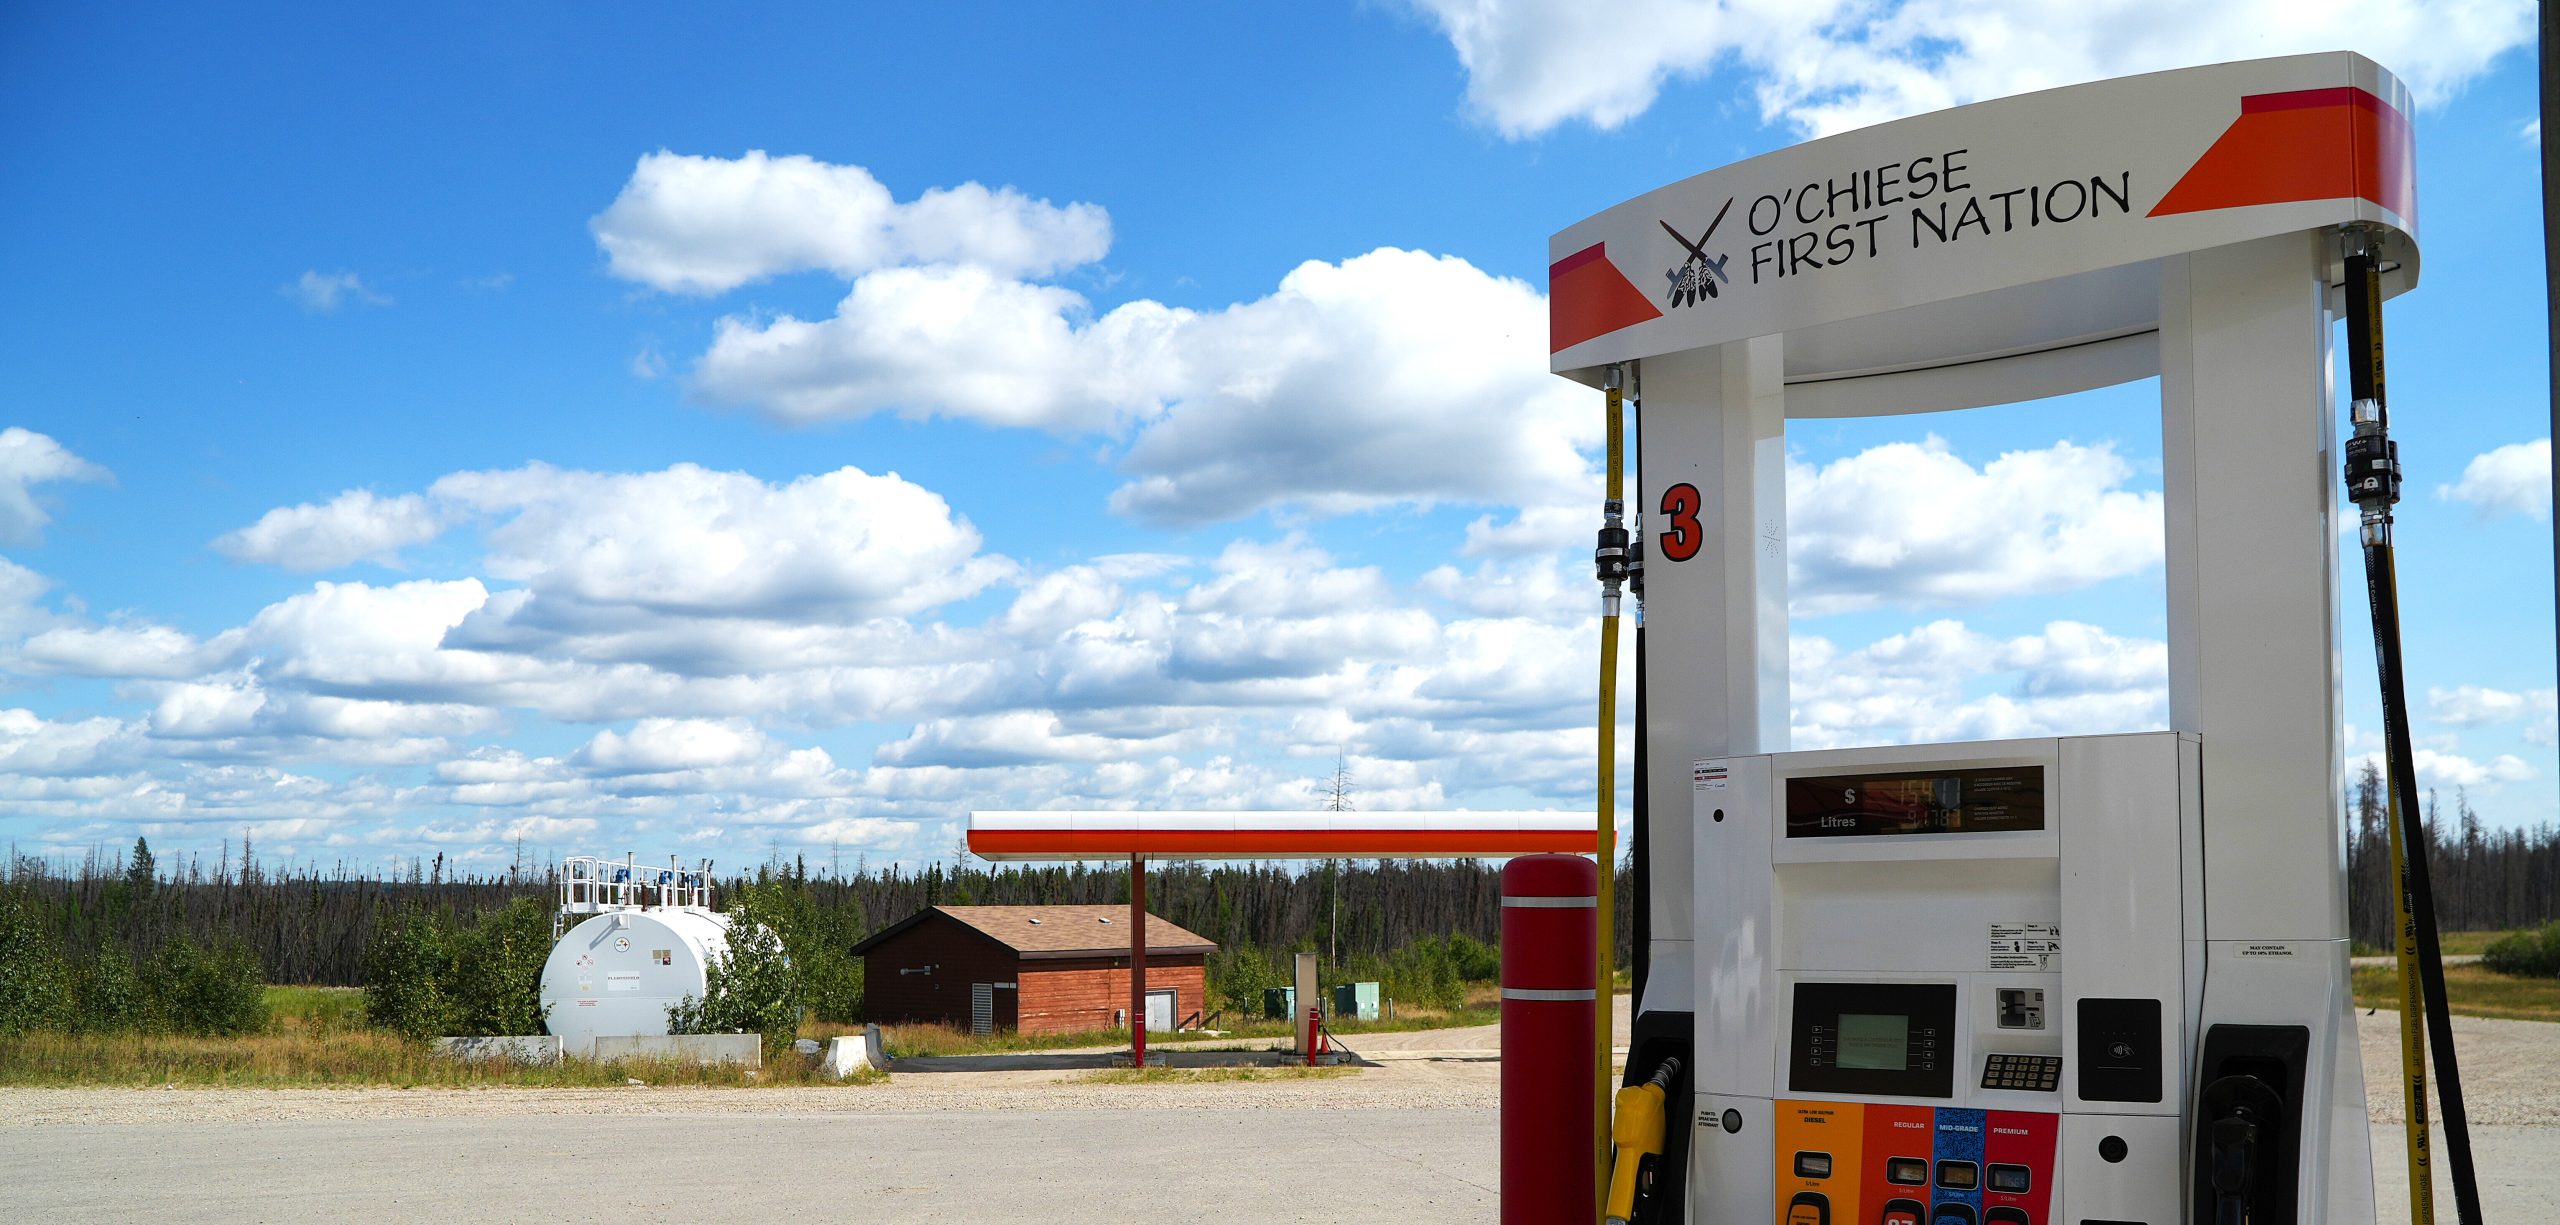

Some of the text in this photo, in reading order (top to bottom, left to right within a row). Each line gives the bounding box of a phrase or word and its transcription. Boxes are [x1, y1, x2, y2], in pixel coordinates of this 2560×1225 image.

[1748, 149, 1971, 236] O'CHIESE
[1751, 171, 2130, 284] FIRST NATION
[1660, 483, 1703, 562] 3
[1844, 788, 1856, 804] $
[1821, 816, 1856, 828] Litres
[2407, 962, 2415, 980] HOSE
[2408, 980, 2417, 1018] DISPENSING
[2410, 1019, 2418, 1034] FUEL
[1893, 1121, 1925, 1129] REGULAR
[1939, 1125, 1979, 1133] MID-GRADE
[1993, 1128, 2029, 1136] PREMIUM
[2419, 1173, 2427, 1190] HOSE
